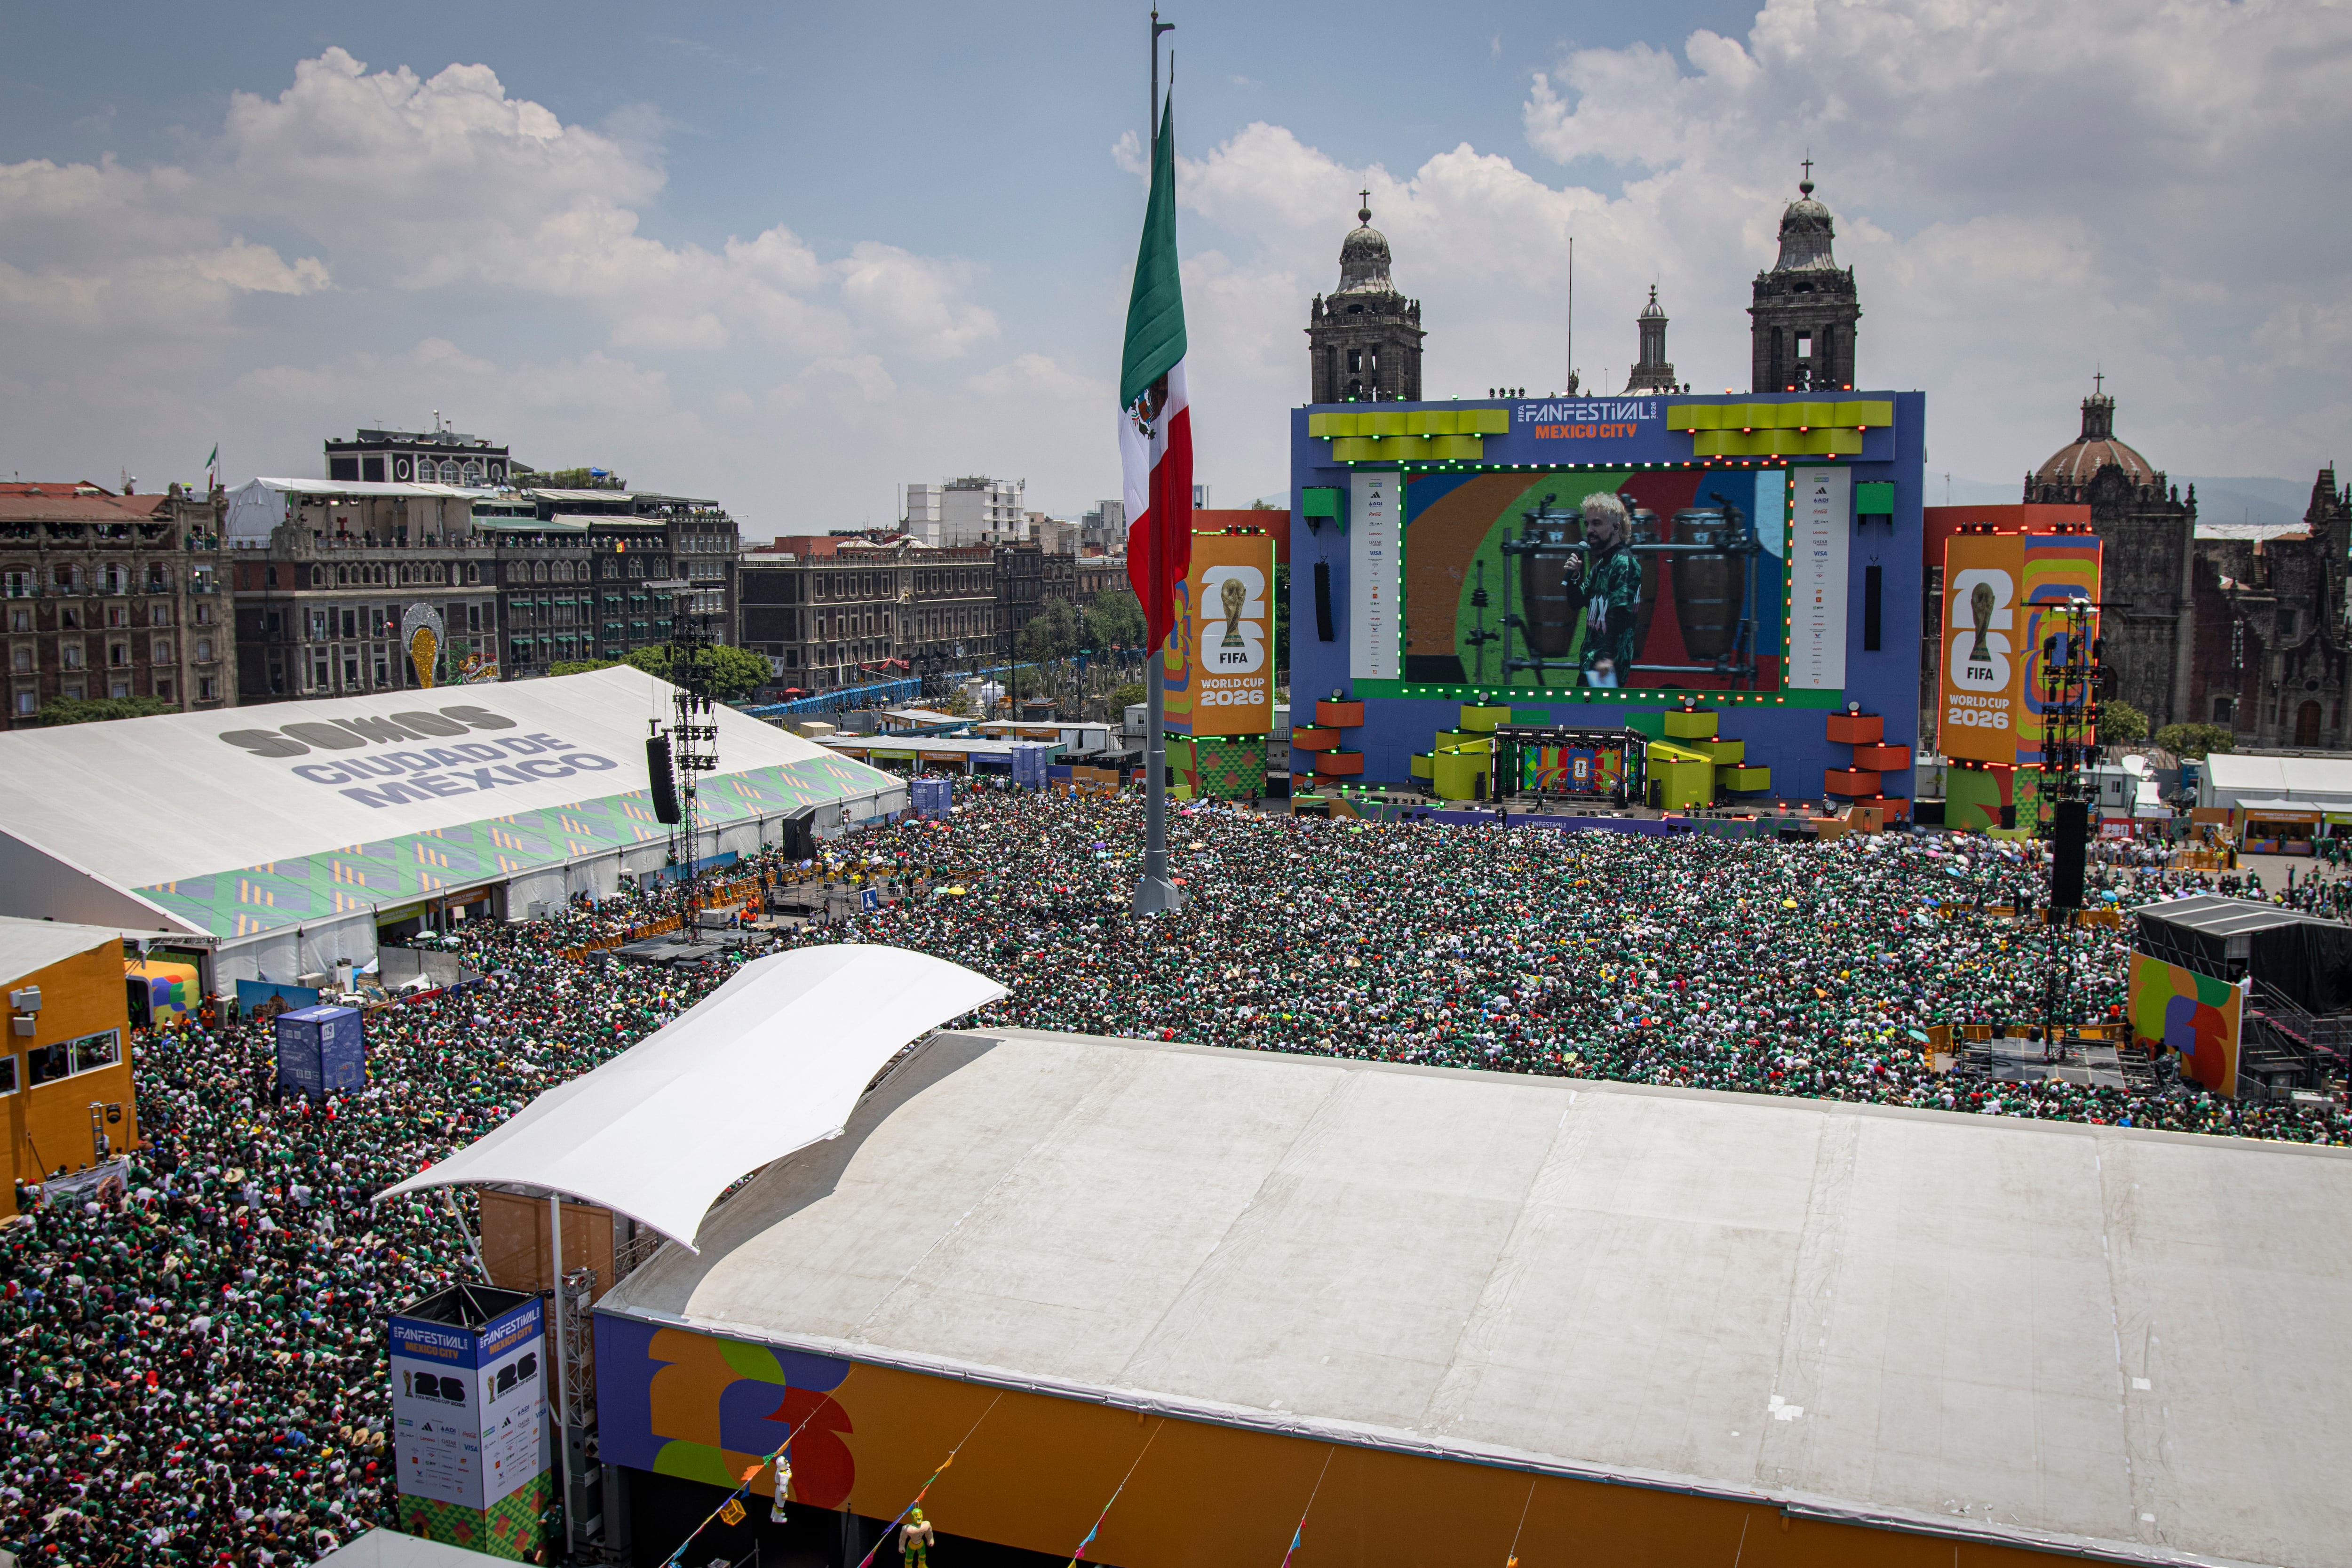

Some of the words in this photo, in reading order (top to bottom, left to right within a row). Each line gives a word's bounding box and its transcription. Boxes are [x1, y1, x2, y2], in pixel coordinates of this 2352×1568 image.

[1535, 424, 1597, 438] MEXICO
[1599, 423, 1637, 438] CITY
[1220, 653, 1248, 664] FIFA
[1967, 667, 1994, 681] FIFA
[1201, 679, 1241, 689] WORLD
[1243, 678, 1264, 687] CUP
[1201, 690, 1264, 706] 2026
[1949, 694, 1987, 708] WORLD
[1988, 697, 2010, 709] CUP
[1948, 708, 2009, 729] 2026
[219, 705, 517, 757] SOMOS
[291, 743, 508, 785] CIUDAD
[492, 733, 578, 755] DE
[338, 753, 618, 808] MÉXICO
[489, 1333, 516, 1355] MEXICO
[517, 1324, 532, 1339] CITY
[405, 1342, 437, 1355] MEXICO
[439, 1348, 459, 1359] CITY
[506, 1385, 518, 1395] WORLD
[525, 1373, 538, 1383] 2026
[535, 1408, 547, 1418] VISA
[464, 1444, 478, 1452] VISA
